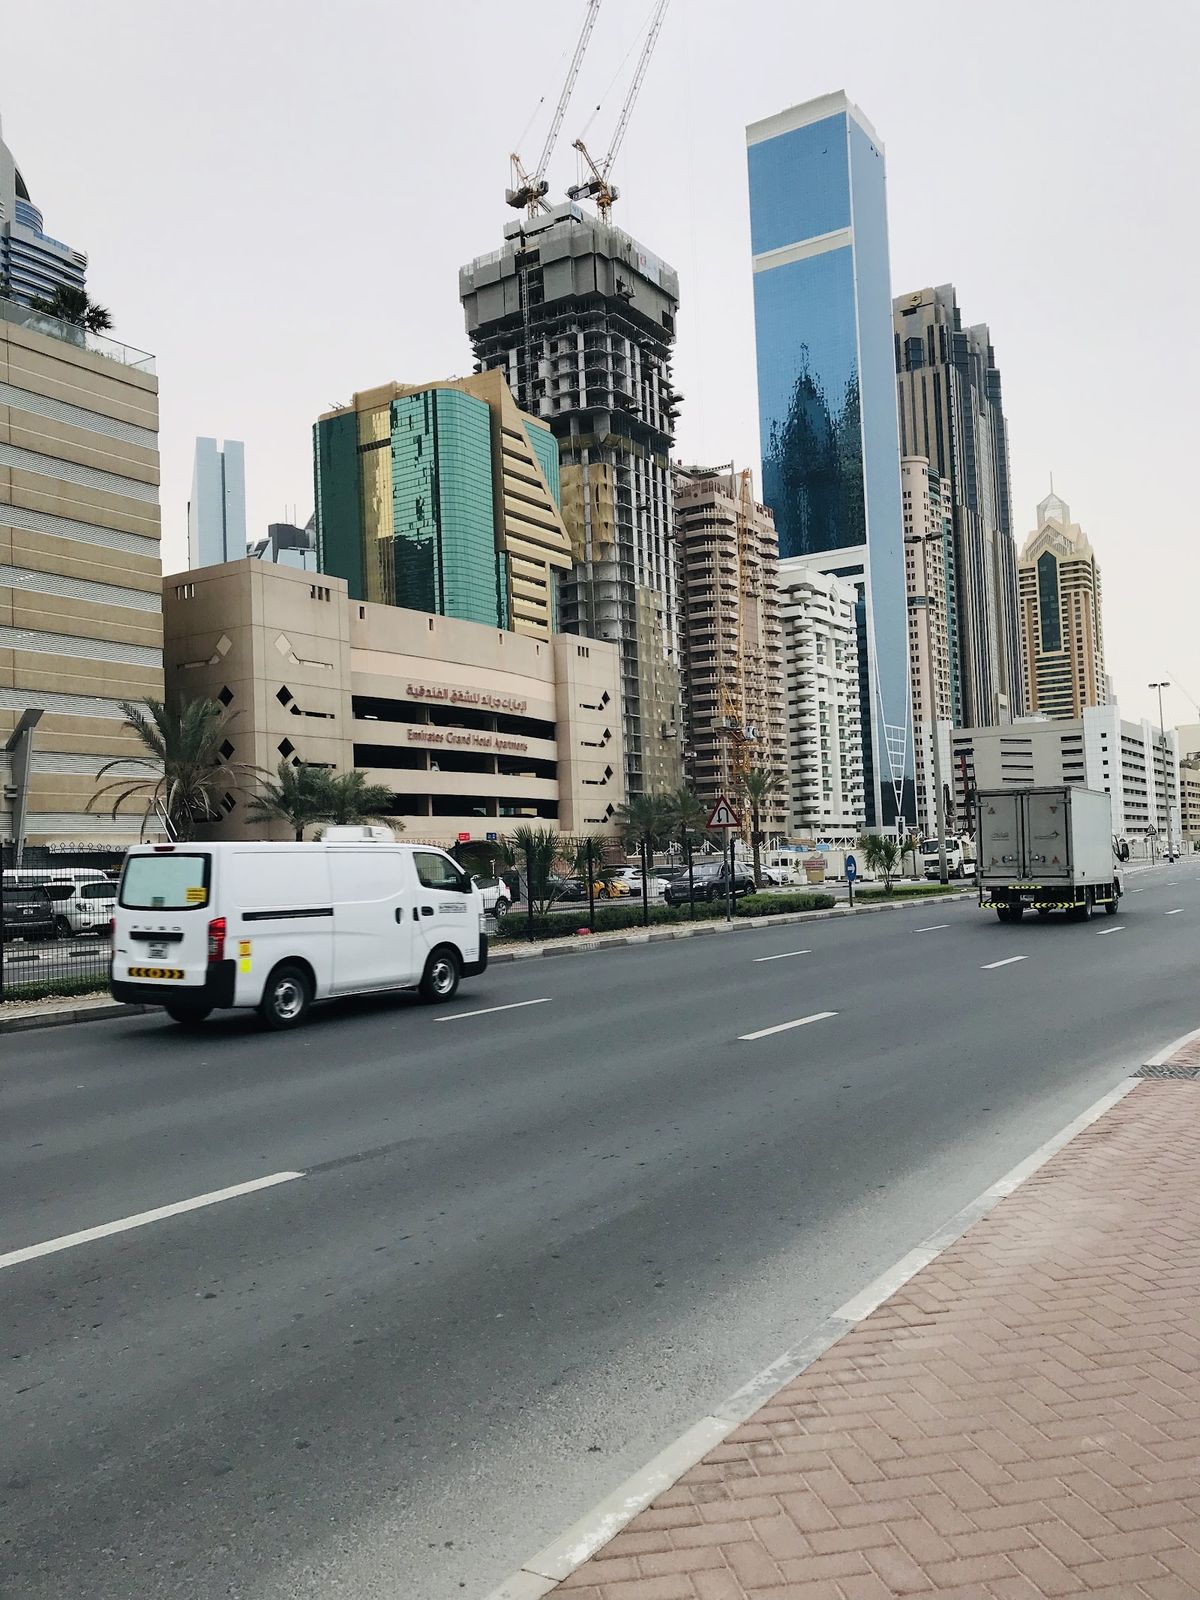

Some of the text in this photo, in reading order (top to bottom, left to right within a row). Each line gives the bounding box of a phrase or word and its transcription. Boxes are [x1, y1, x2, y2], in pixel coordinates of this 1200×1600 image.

[406, 684, 449, 700] الفندقية
[450, 690, 480, 704] للشقق
[407, 728, 444, 743] Emirates
[446, 732, 471, 745] Grand
[472, 734, 492, 747] Hotel
